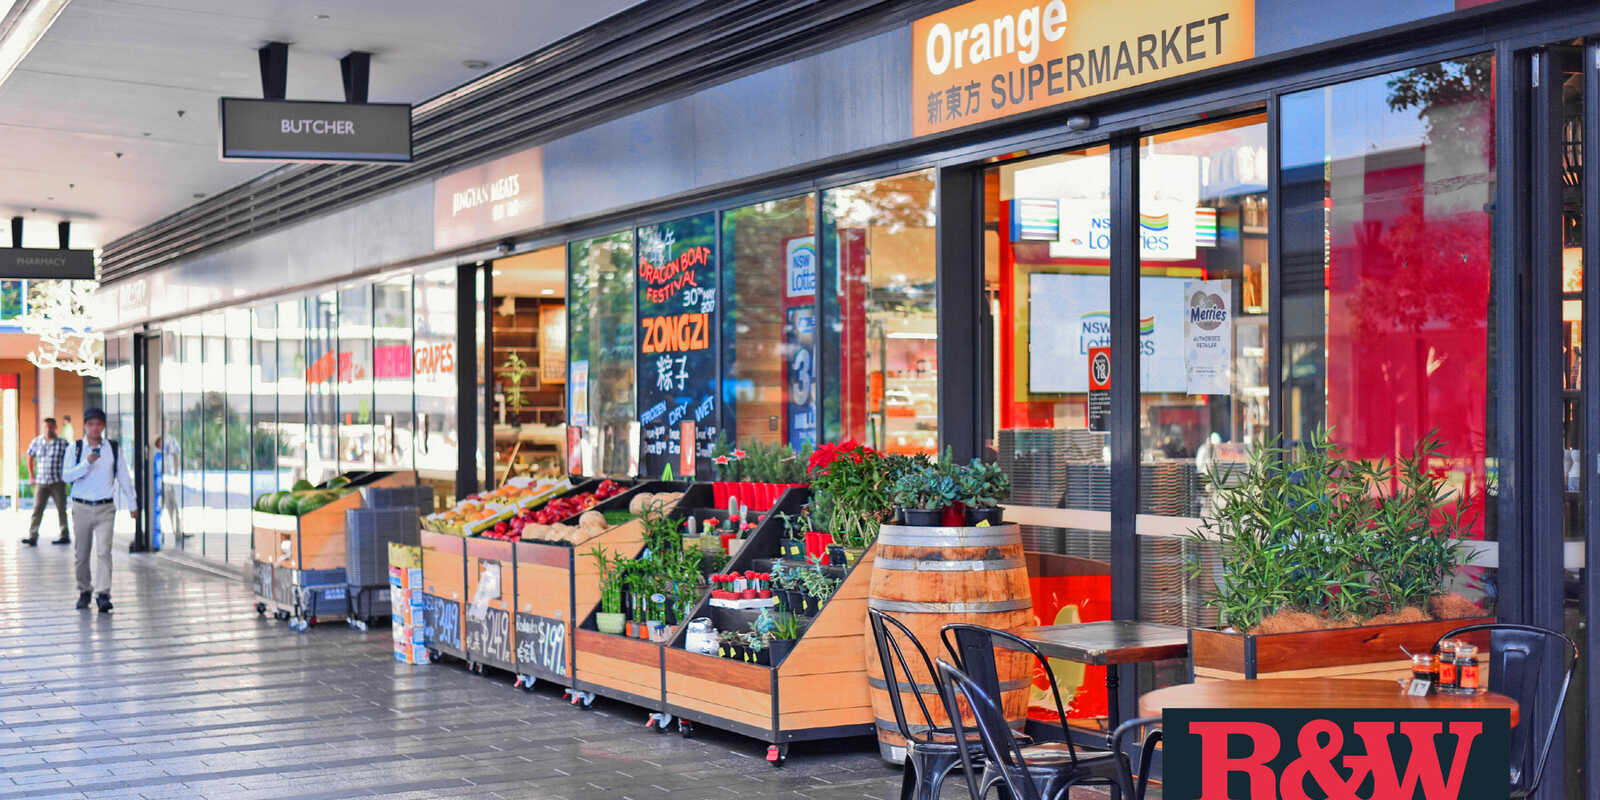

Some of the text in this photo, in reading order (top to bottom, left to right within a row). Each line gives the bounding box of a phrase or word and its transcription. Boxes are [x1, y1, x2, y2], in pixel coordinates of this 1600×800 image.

[926, 0, 1067, 75] Orange
[927, 13, 1229, 124] 新東方 SUPERMARKET
[281, 119, 355, 135] BUTCHER
[490, 174, 519, 202] MEATS
[16, 256, 66, 267] PHARMACY
[639, 246, 711, 284] DRAGON BOAT
[646, 270, 698, 303] FESTIVAL
[1190, 306, 1227, 323] Merries
[642, 313, 709, 353] ZONGZI
[414, 343, 454, 374] GRAPES
[656, 354, 689, 391] 粽子
[641, 395, 714, 426] FROZEN DRY WET
